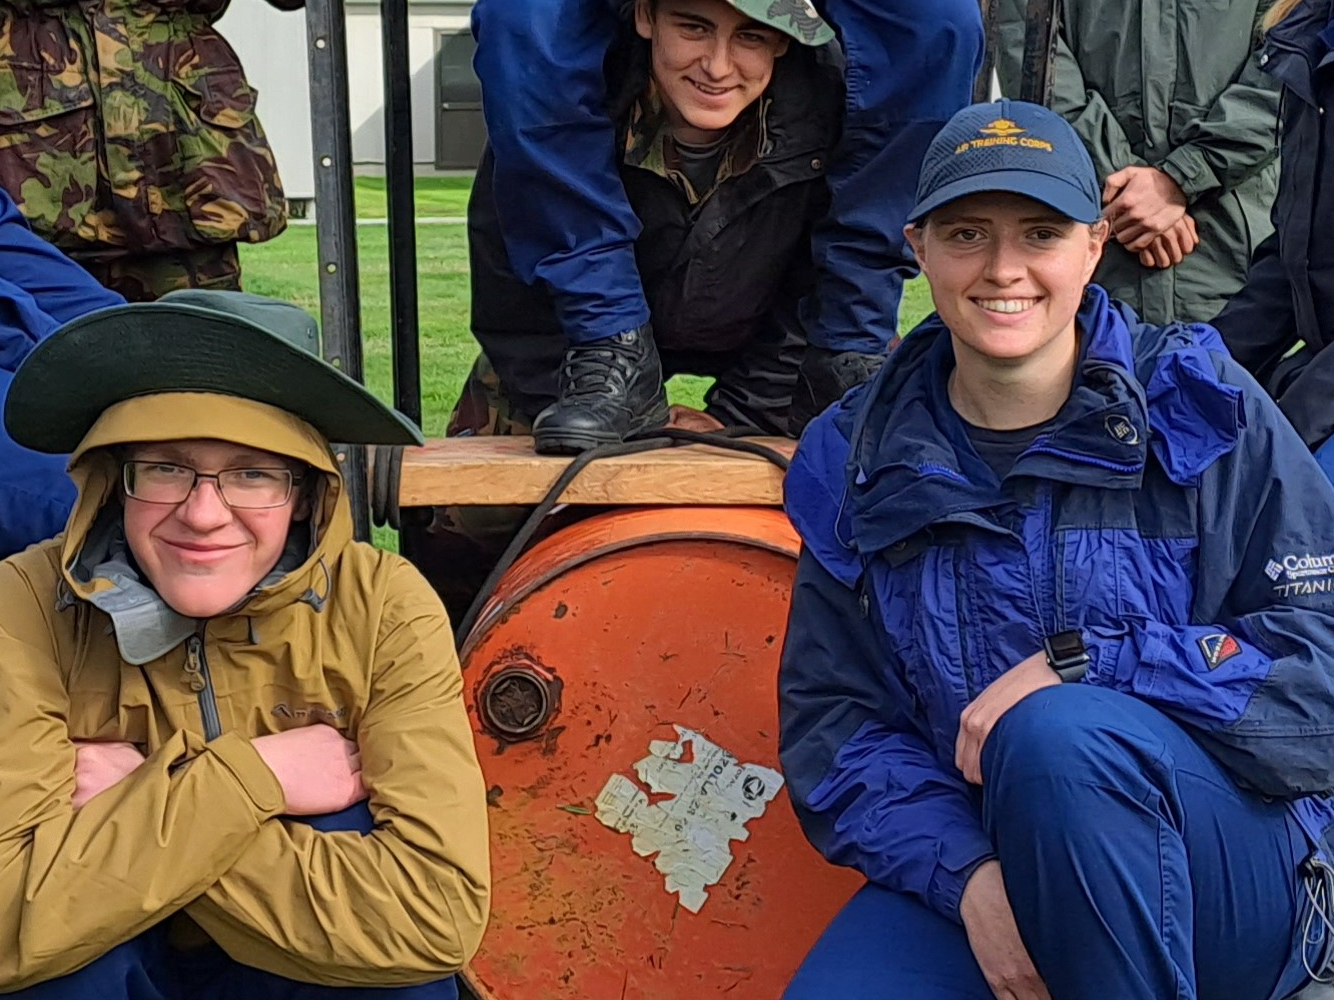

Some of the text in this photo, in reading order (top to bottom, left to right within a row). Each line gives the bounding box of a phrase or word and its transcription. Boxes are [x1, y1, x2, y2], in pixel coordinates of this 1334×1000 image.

[955, 136, 1053, 155] AIR TRAINING CORPS
